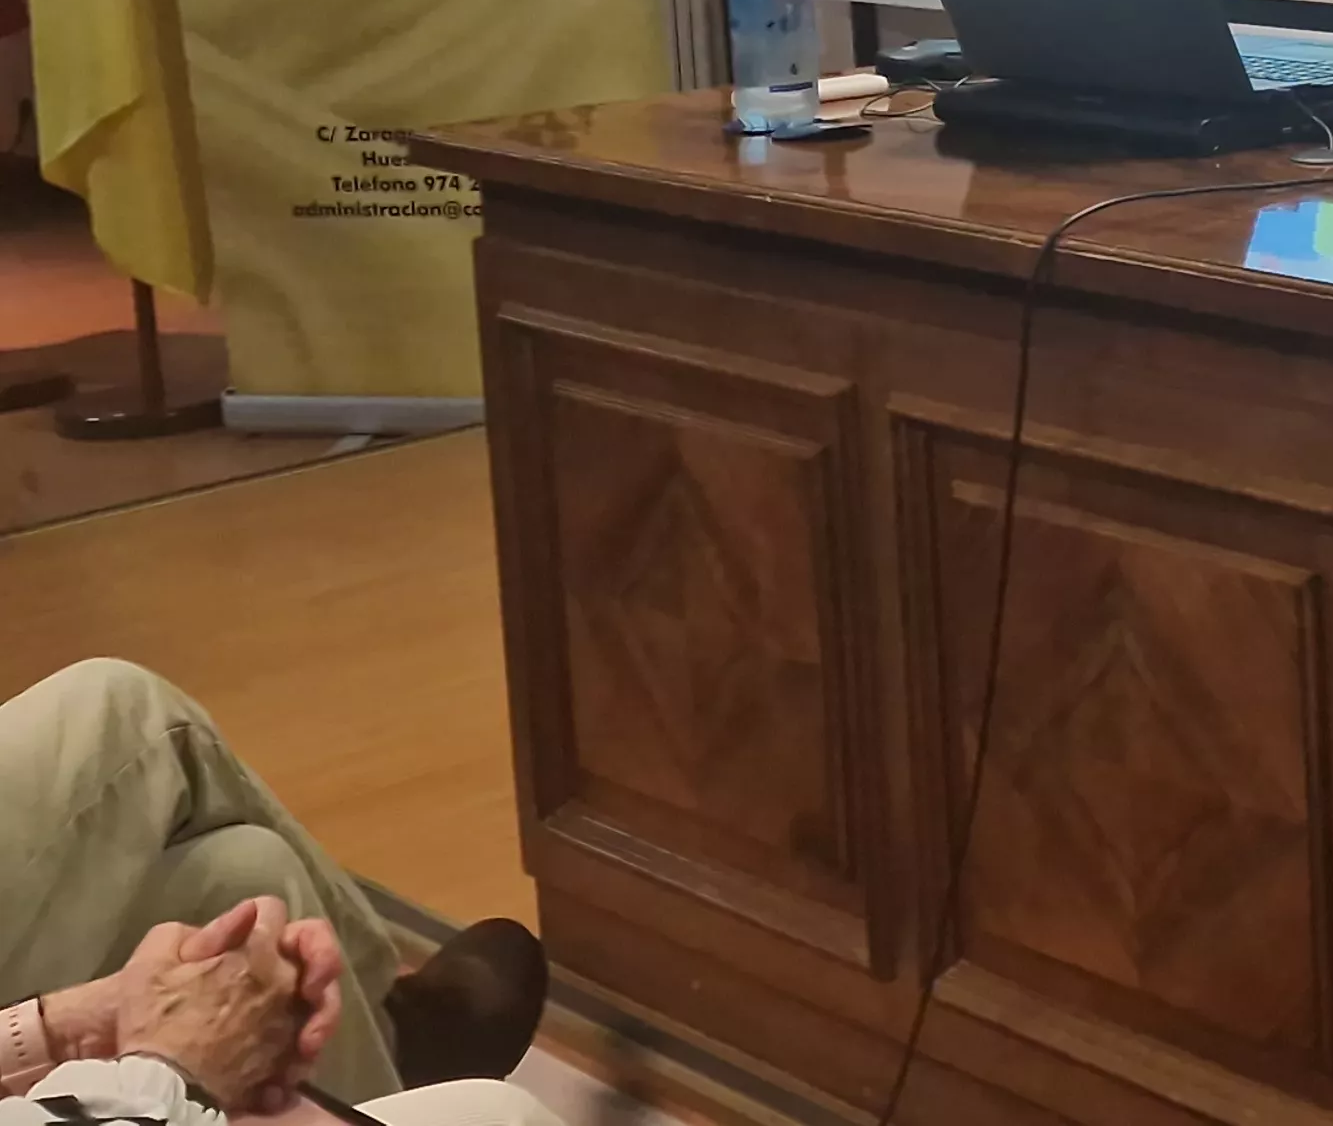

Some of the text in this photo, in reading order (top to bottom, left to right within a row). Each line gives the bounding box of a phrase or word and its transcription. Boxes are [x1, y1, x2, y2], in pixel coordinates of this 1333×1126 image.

[316, 126, 336, 143] C/
[423, 175, 461, 192] 974
[470, 177, 482, 192] 2
